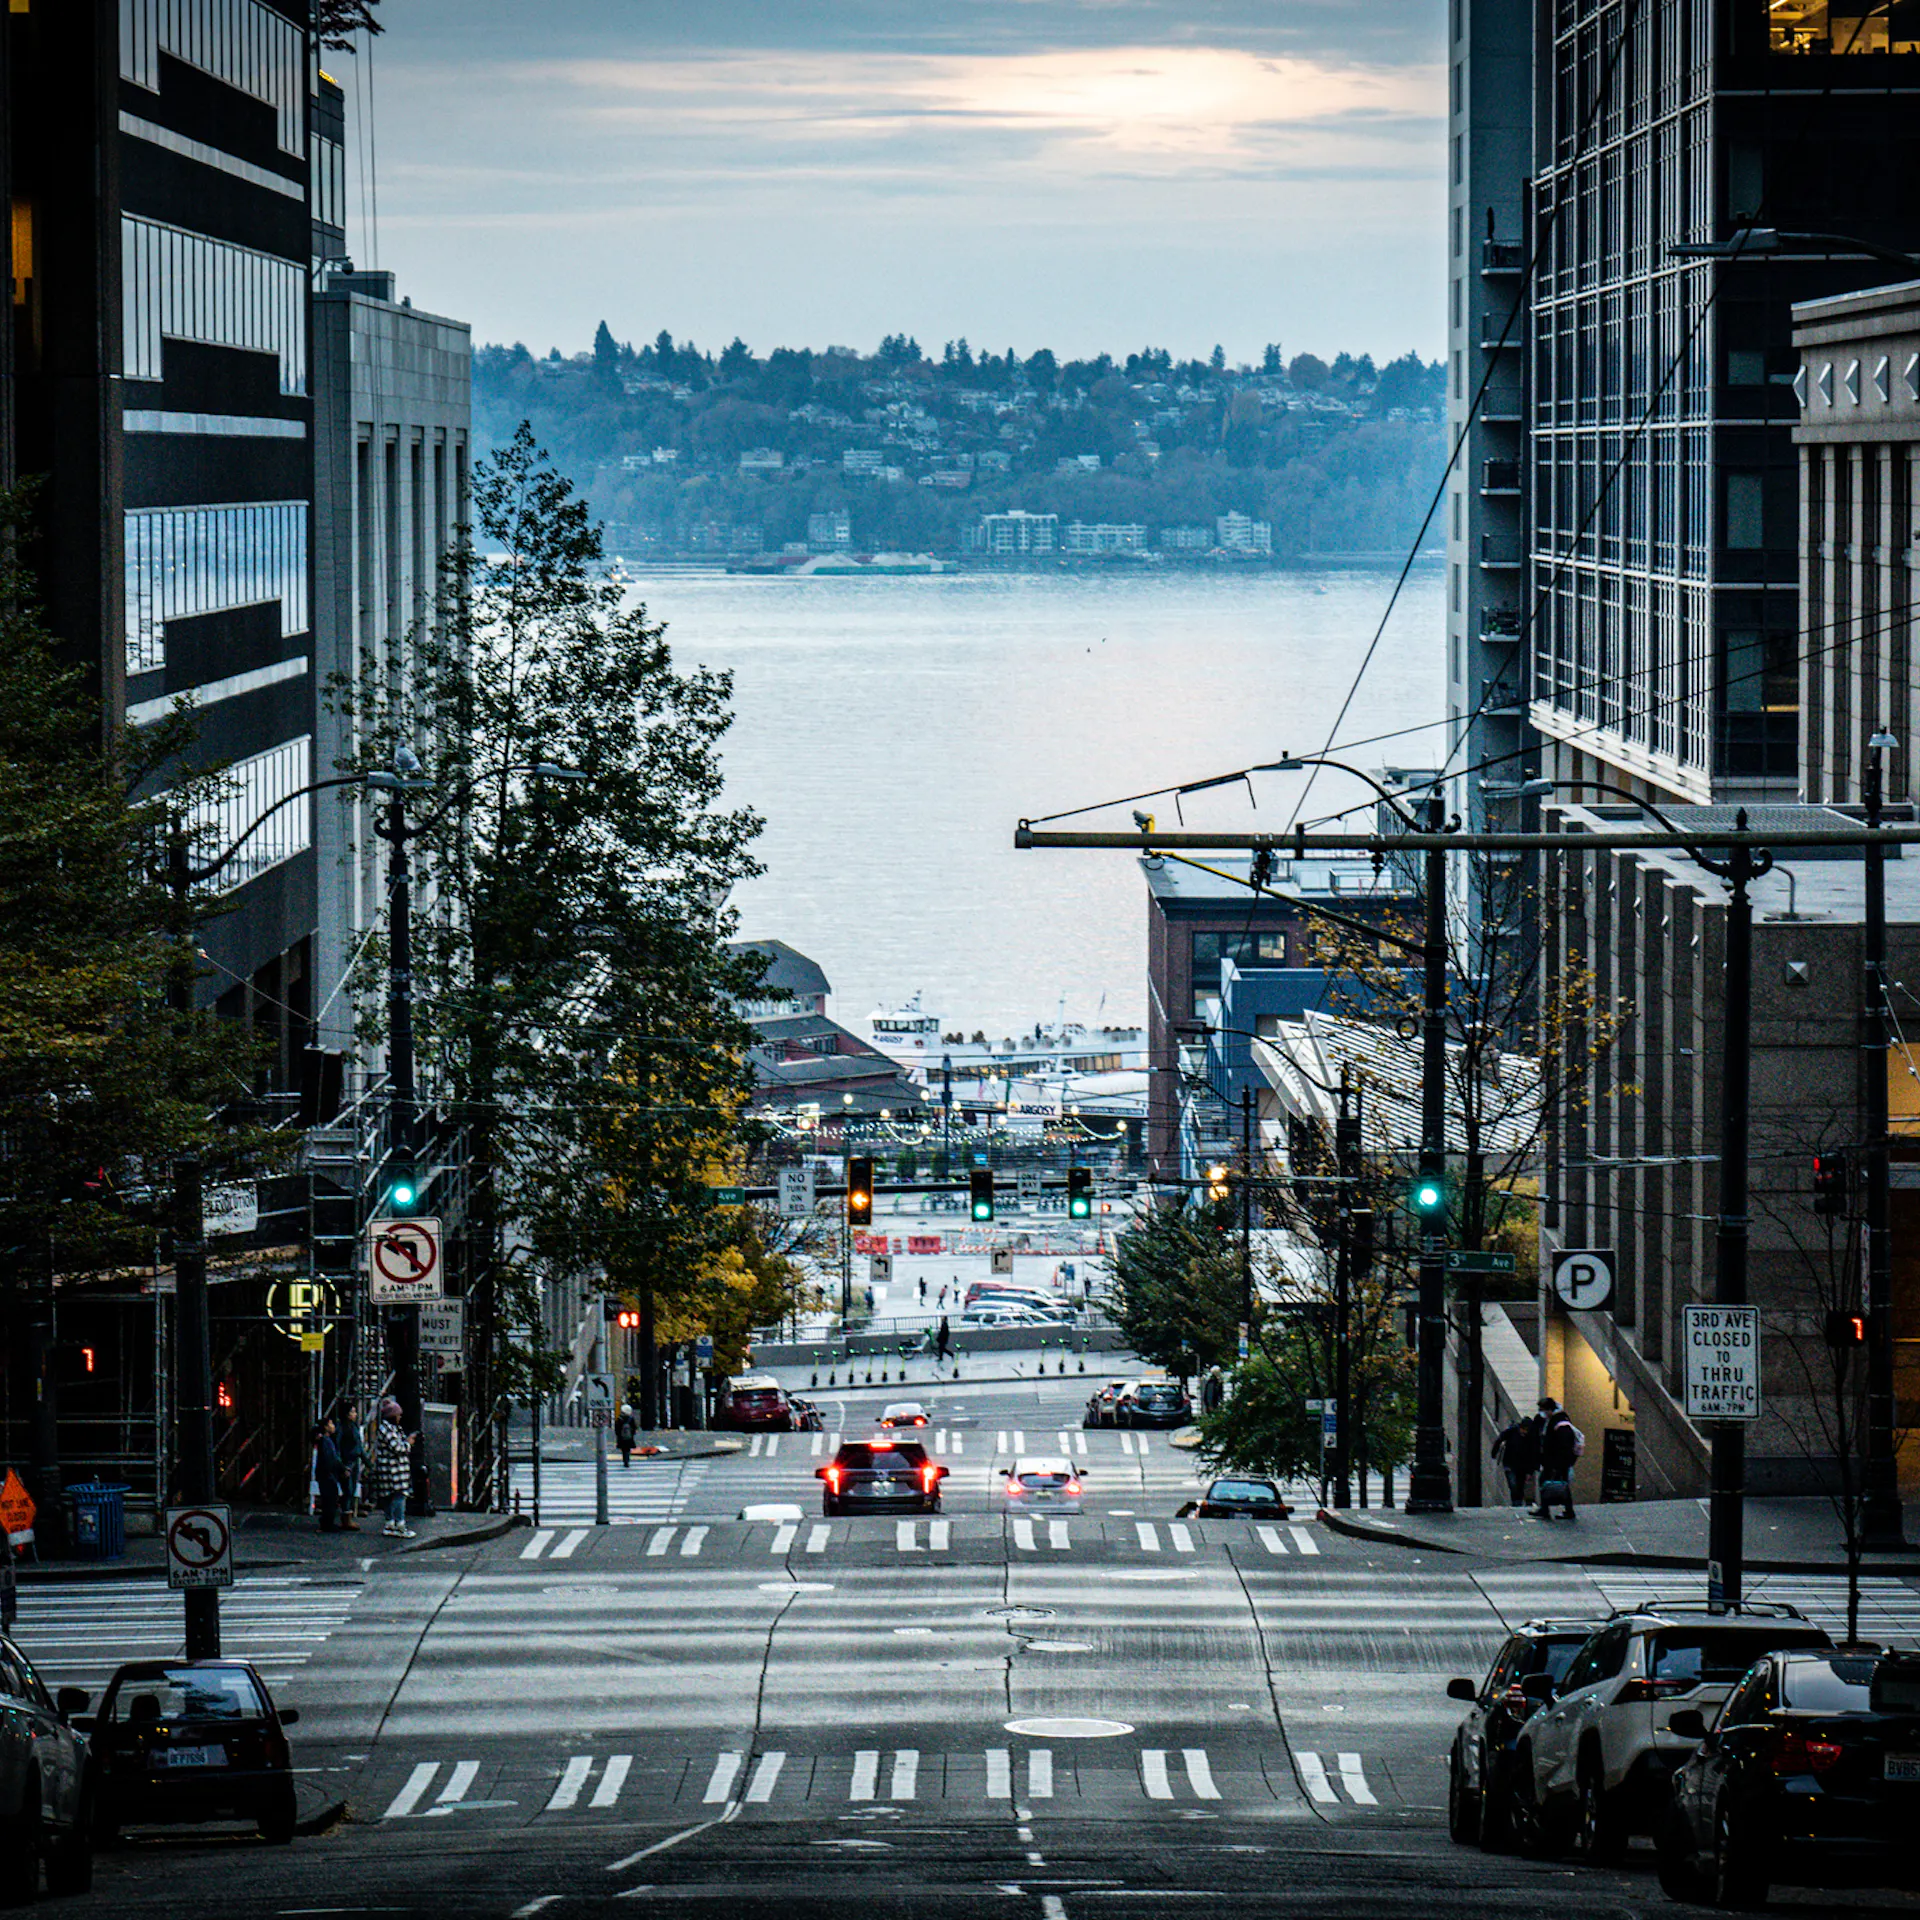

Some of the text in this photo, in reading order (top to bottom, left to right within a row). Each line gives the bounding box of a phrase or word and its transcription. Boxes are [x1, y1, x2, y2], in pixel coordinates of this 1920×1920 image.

[880, 1035, 903, 1044] ARGOSY
[1020, 1104, 1055, 1116] ARGOSY
[788, 1173, 805, 1183] NO
[718, 1191, 736, 1200] Ave
[791, 1194, 802, 1202] ON
[1491, 1254, 1511, 1268] Ave
[1571, 1264, 1596, 1300] P
[438, 1304, 459, 1313] LANE
[422, 1319, 450, 1329] MUST
[1692, 1313, 1752, 1328] 3RD AVE
[439, 1336, 459, 1344] LEFT
[1693, 1332, 1751, 1347] CLOSED
[1716, 1351, 1731, 1363] TO
[1702, 1367, 1744, 1382] THRU
[1691, 1385, 1754, 1400] TRAFFIC
